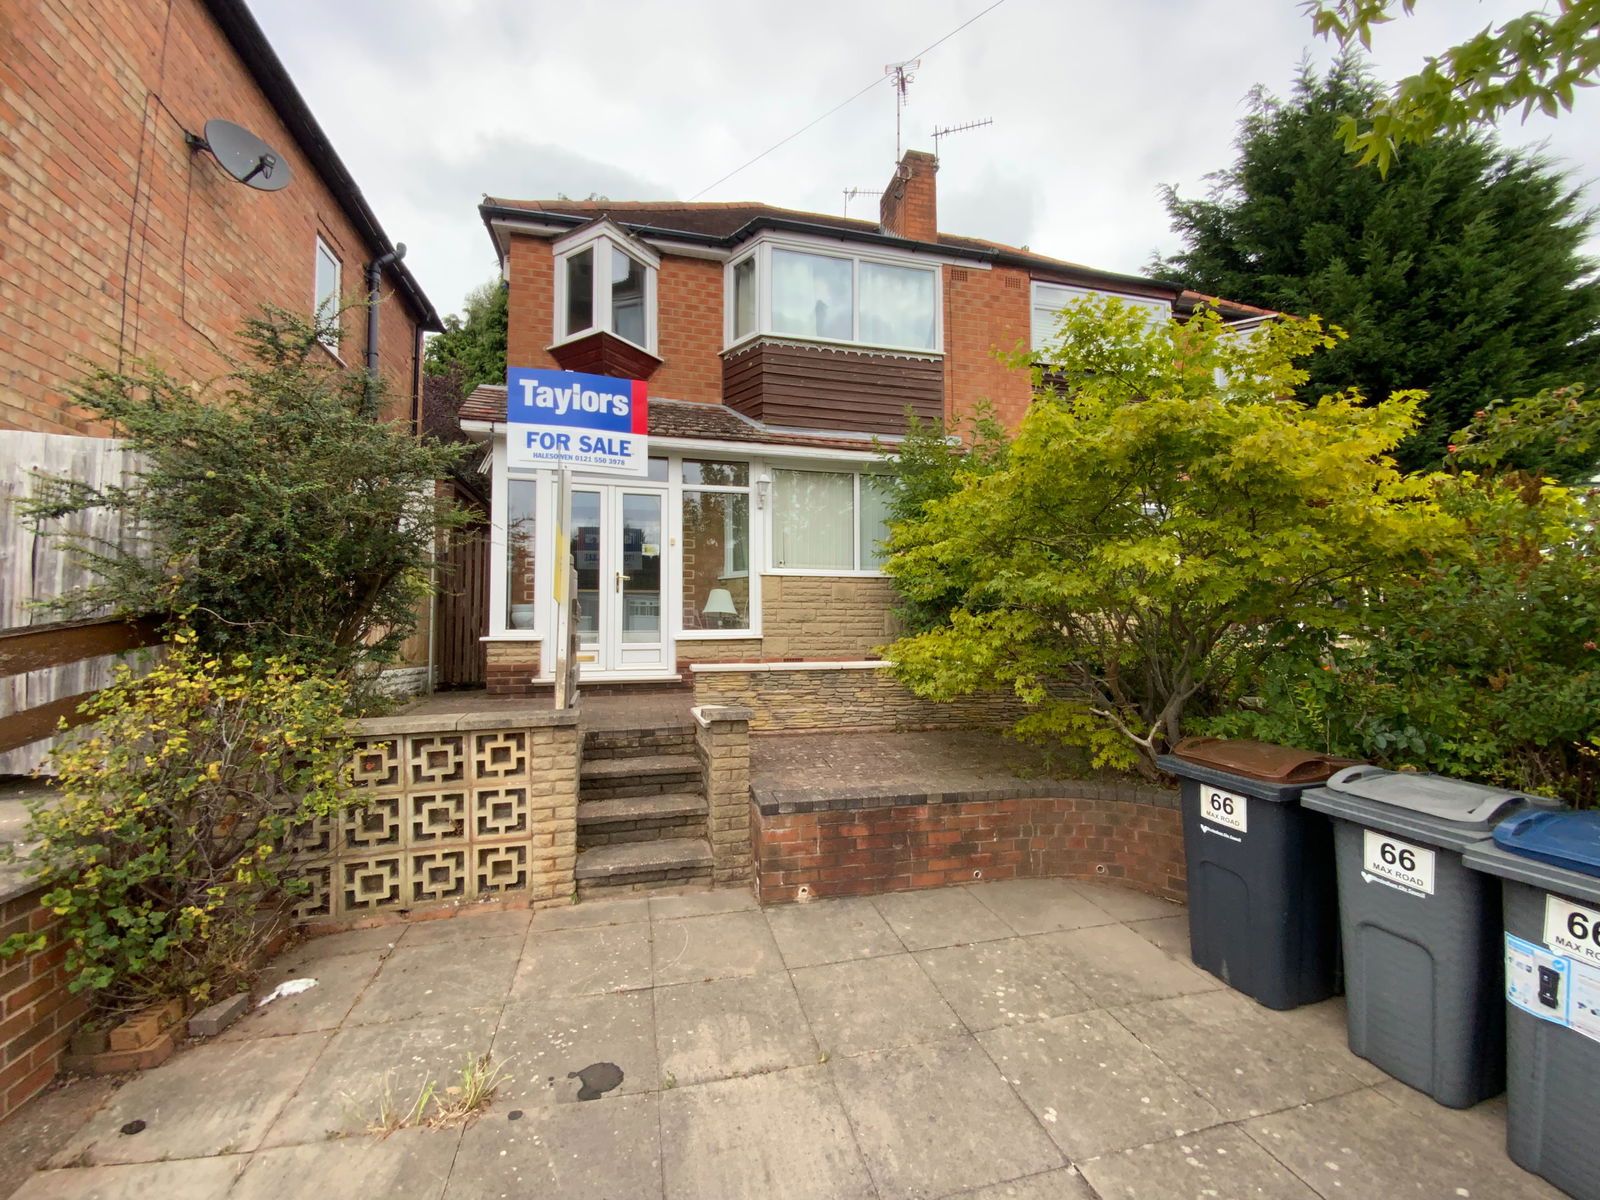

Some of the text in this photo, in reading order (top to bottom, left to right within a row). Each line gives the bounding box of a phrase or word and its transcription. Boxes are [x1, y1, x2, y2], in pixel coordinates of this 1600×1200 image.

[519, 378, 630, 416] Taylors
[526, 431, 632, 457] FOR SALE
[532, 452, 573, 461] HALESOWEN
[594, 456, 607, 464] 550
[608, 458, 626, 466] 3978
[1211, 793, 1234, 815] 66
[1206, 810, 1240, 827] MAX ROAD
[1380, 842, 1416, 872] 66
[1372, 862, 1393, 875] MAX
[1395, 871, 1424, 887] ROAD
[1555, 936, 1600, 961] MAX RO
